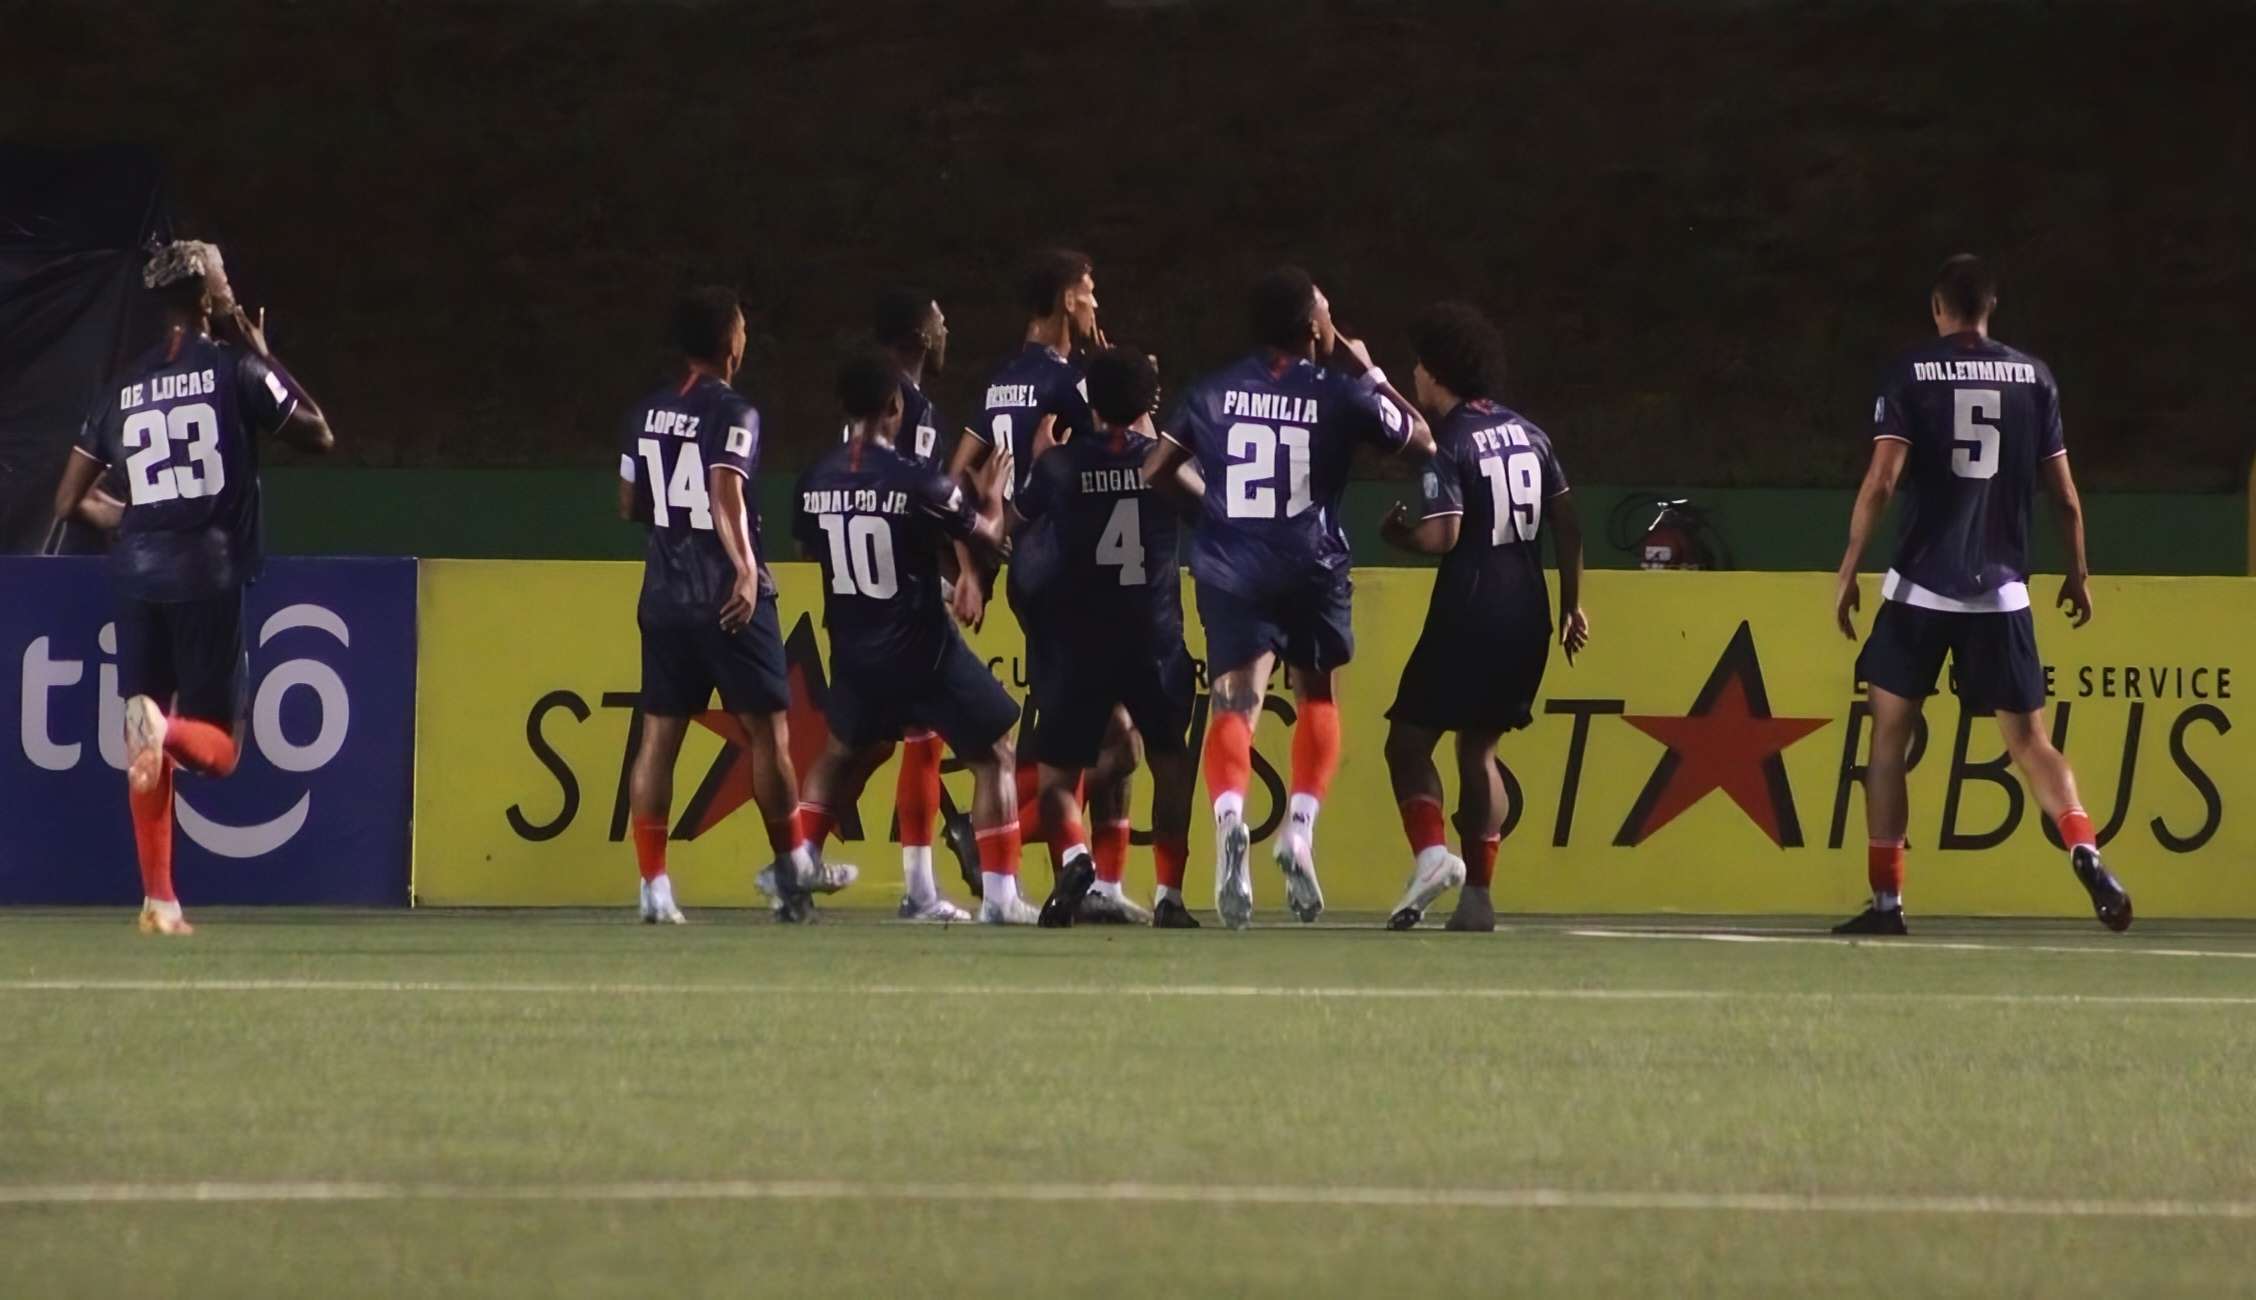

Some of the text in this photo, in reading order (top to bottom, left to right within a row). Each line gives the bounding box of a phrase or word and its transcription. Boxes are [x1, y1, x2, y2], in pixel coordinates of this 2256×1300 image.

[120, 369, 216, 410] DE LUCAS
[1223, 390, 1319, 424] FAMILIA
[1913, 360, 2036, 384] DOLLENMAYER
[122, 402, 226, 507] 23
[644, 408, 700, 438] LOPEZ
[1952, 388, 2001, 480] 5
[637, 437, 715, 530] 14
[1226, 422, 1314, 519] 21
[1479, 451, 1542, 547] 19
[818, 513, 899, 600] 10
[1095, 497, 1147, 587] 4
[2077, 665, 2233, 699] SERVICE
